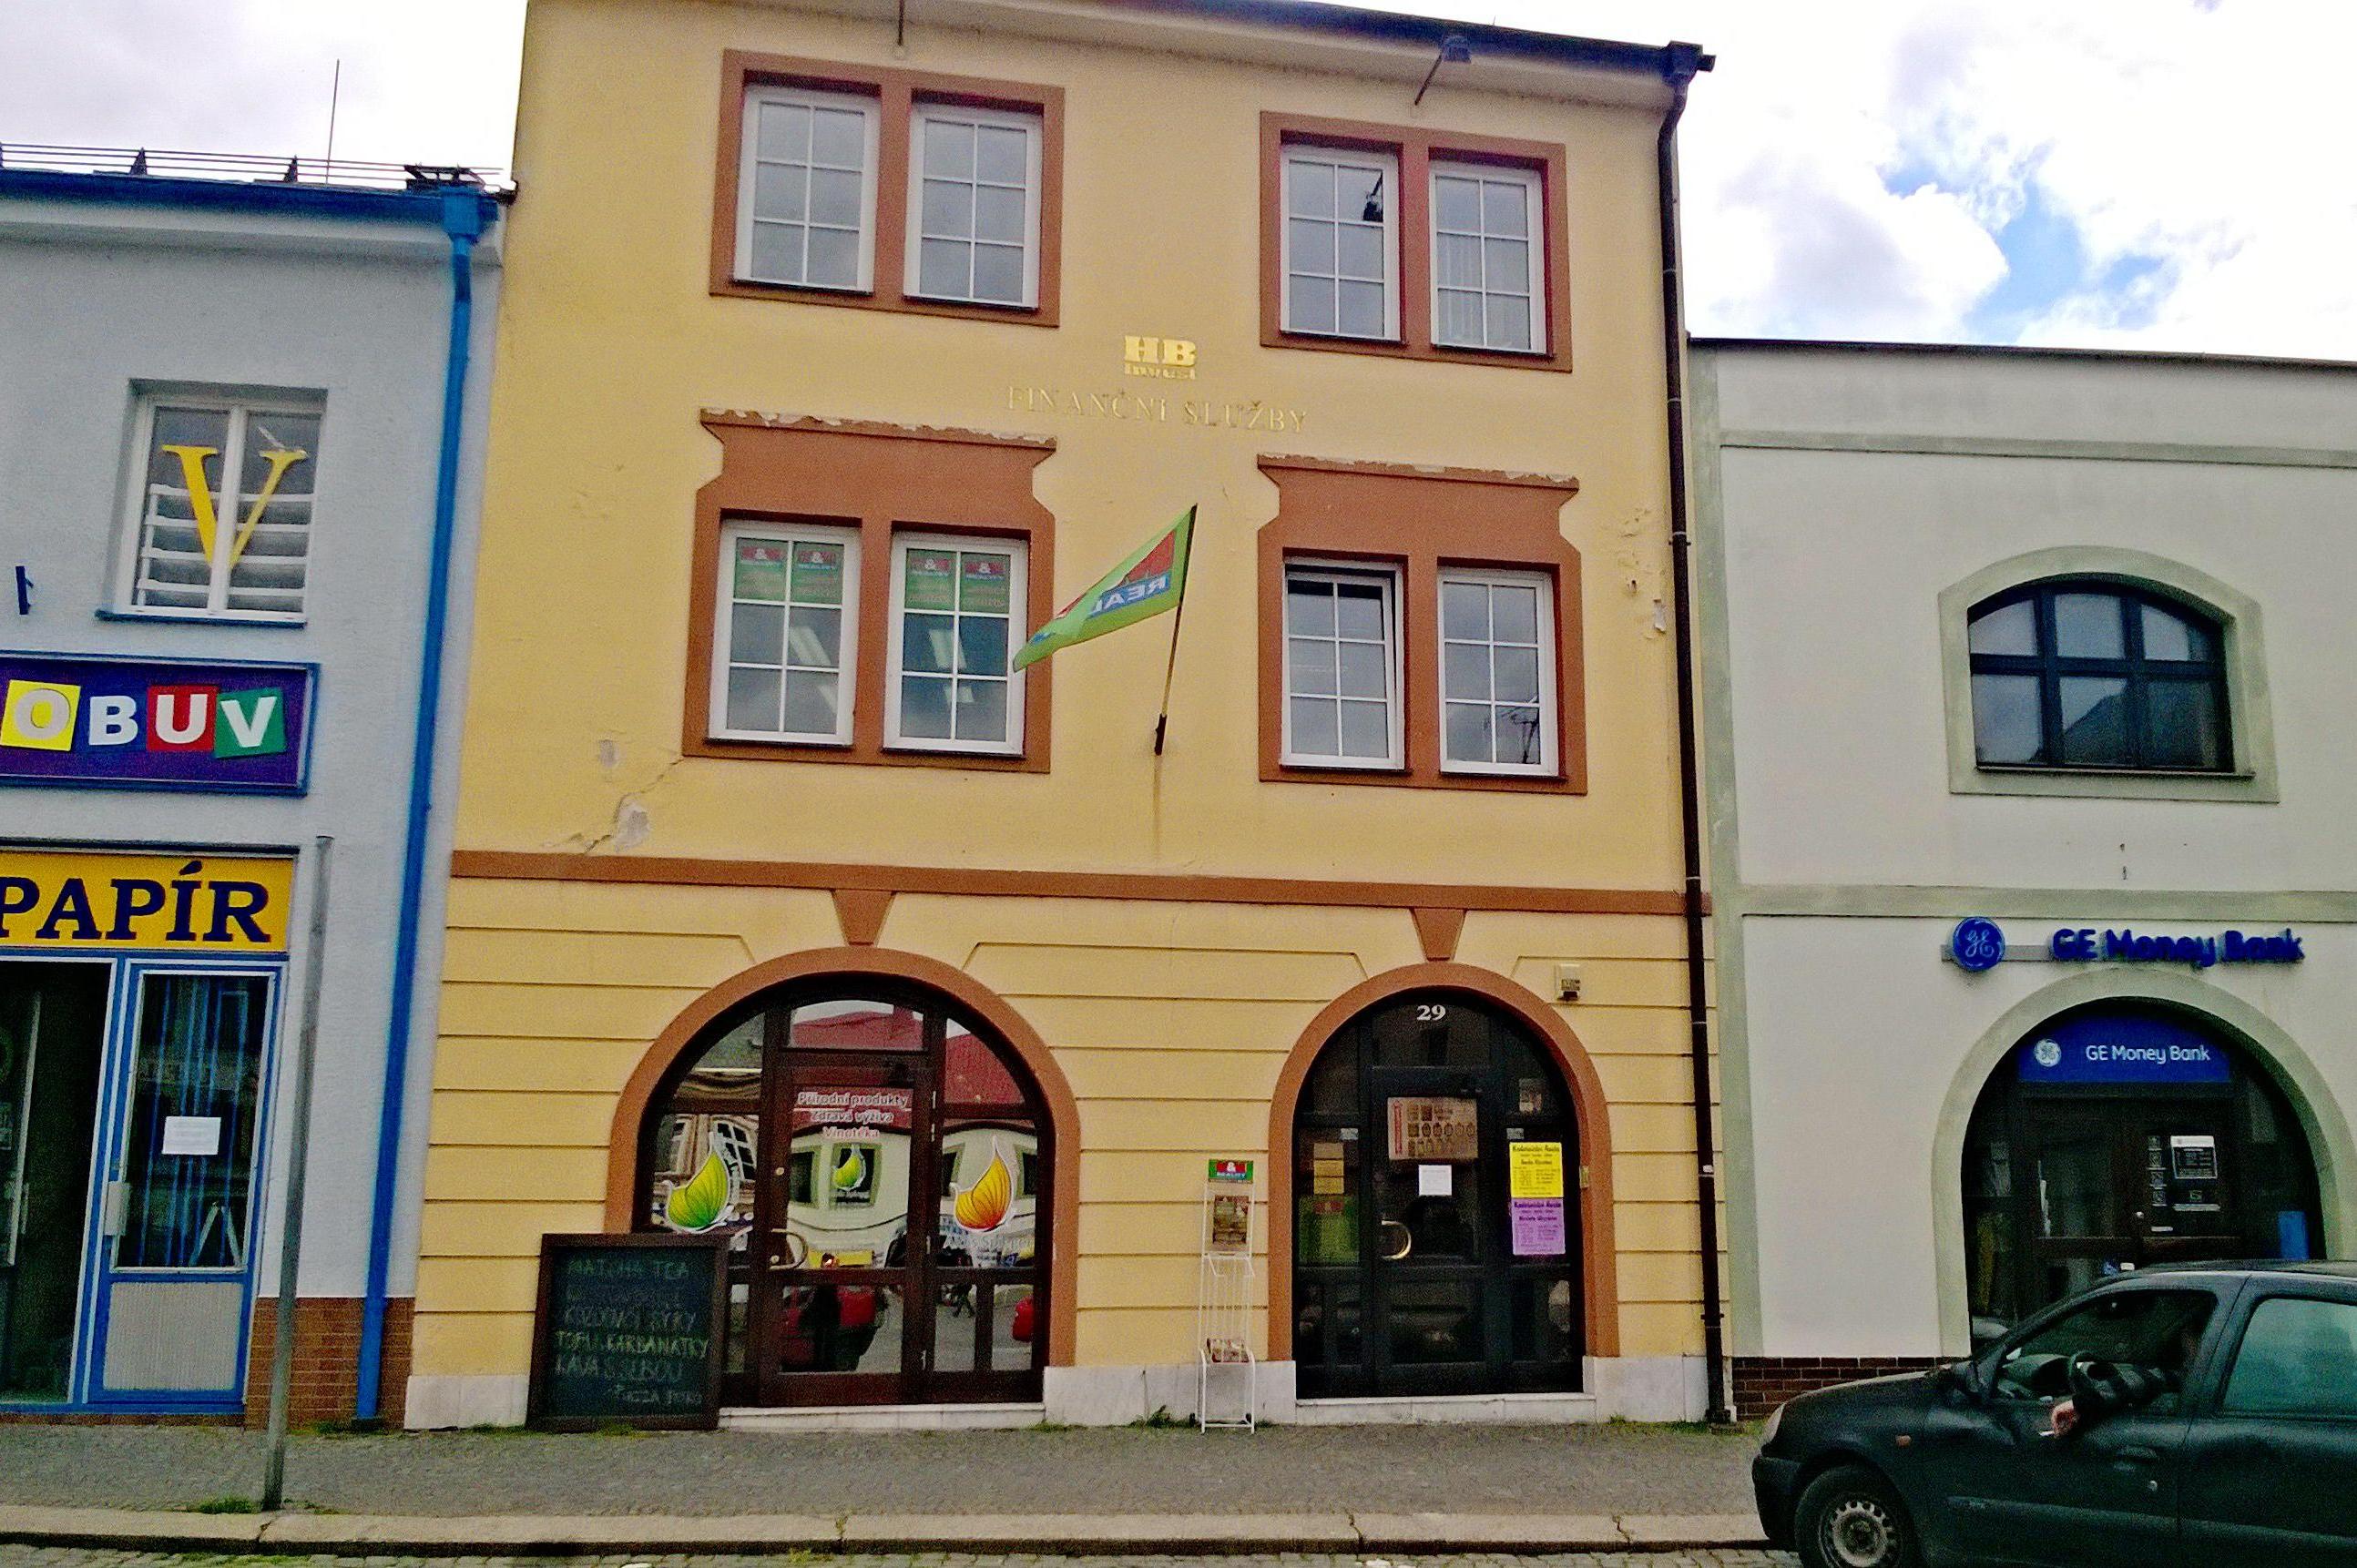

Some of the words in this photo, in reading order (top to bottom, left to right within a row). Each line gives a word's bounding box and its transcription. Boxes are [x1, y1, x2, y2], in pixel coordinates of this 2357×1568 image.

[1124, 335, 1196, 366] HB
[1183, 401, 1308, 433] SLUŽBY
[15, 688, 277, 748] OBUV
[0, 860, 271, 942] PAPÍR
[2053, 929, 2096, 961] GE
[2104, 929, 2216, 967] Money
[2221, 928, 2305, 962] Bank
[1416, 1004, 1446, 1021] 29
[2086, 1044, 2109, 1061] GE
[2111, 1044, 2167, 1064] Money
[2168, 1044, 2211, 1062] Bank
[851, 1093, 908, 1109] produkty
